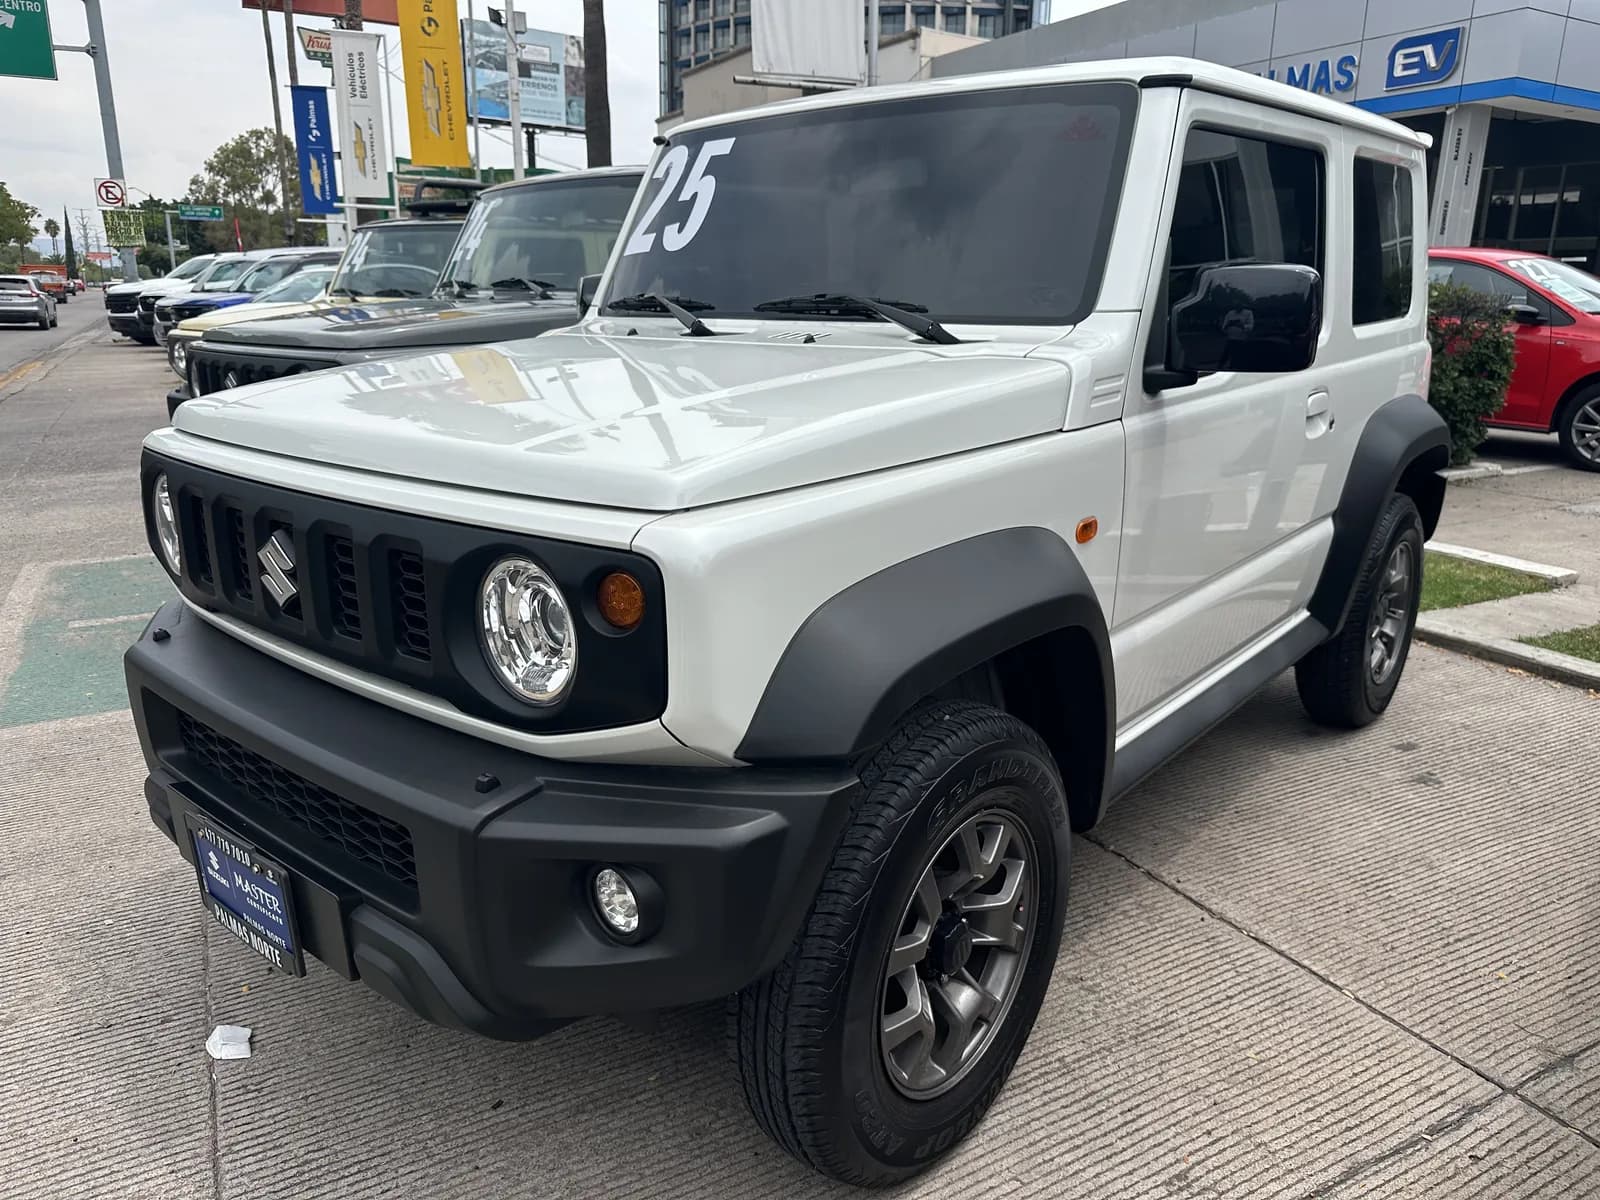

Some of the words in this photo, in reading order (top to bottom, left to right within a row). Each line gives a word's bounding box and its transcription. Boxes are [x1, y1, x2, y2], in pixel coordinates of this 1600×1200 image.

[346, 52, 358, 99] Vehículos
[357, 51, 368, 99] Eléctricos
[1393, 39, 1455, 77] EV
[309, 100, 318, 128] Palmas
[441, 59, 455, 141] CHEVROLET
[368, 117, 378, 180] CHEVROLET
[321, 153, 330, 201] CHEVROLET
[623, 137, 736, 256] 25
[340, 231, 373, 274] 24
[217, 836, 230, 855] 779
[230, 844, 251, 867] 7010
[233, 872, 282, 914] MASTER
[214, 904, 250, 944] PALMAS
[250, 931, 283, 968] NORTE
[243, 913, 266, 935] PALMAS
[266, 928, 287, 949] NORTE
